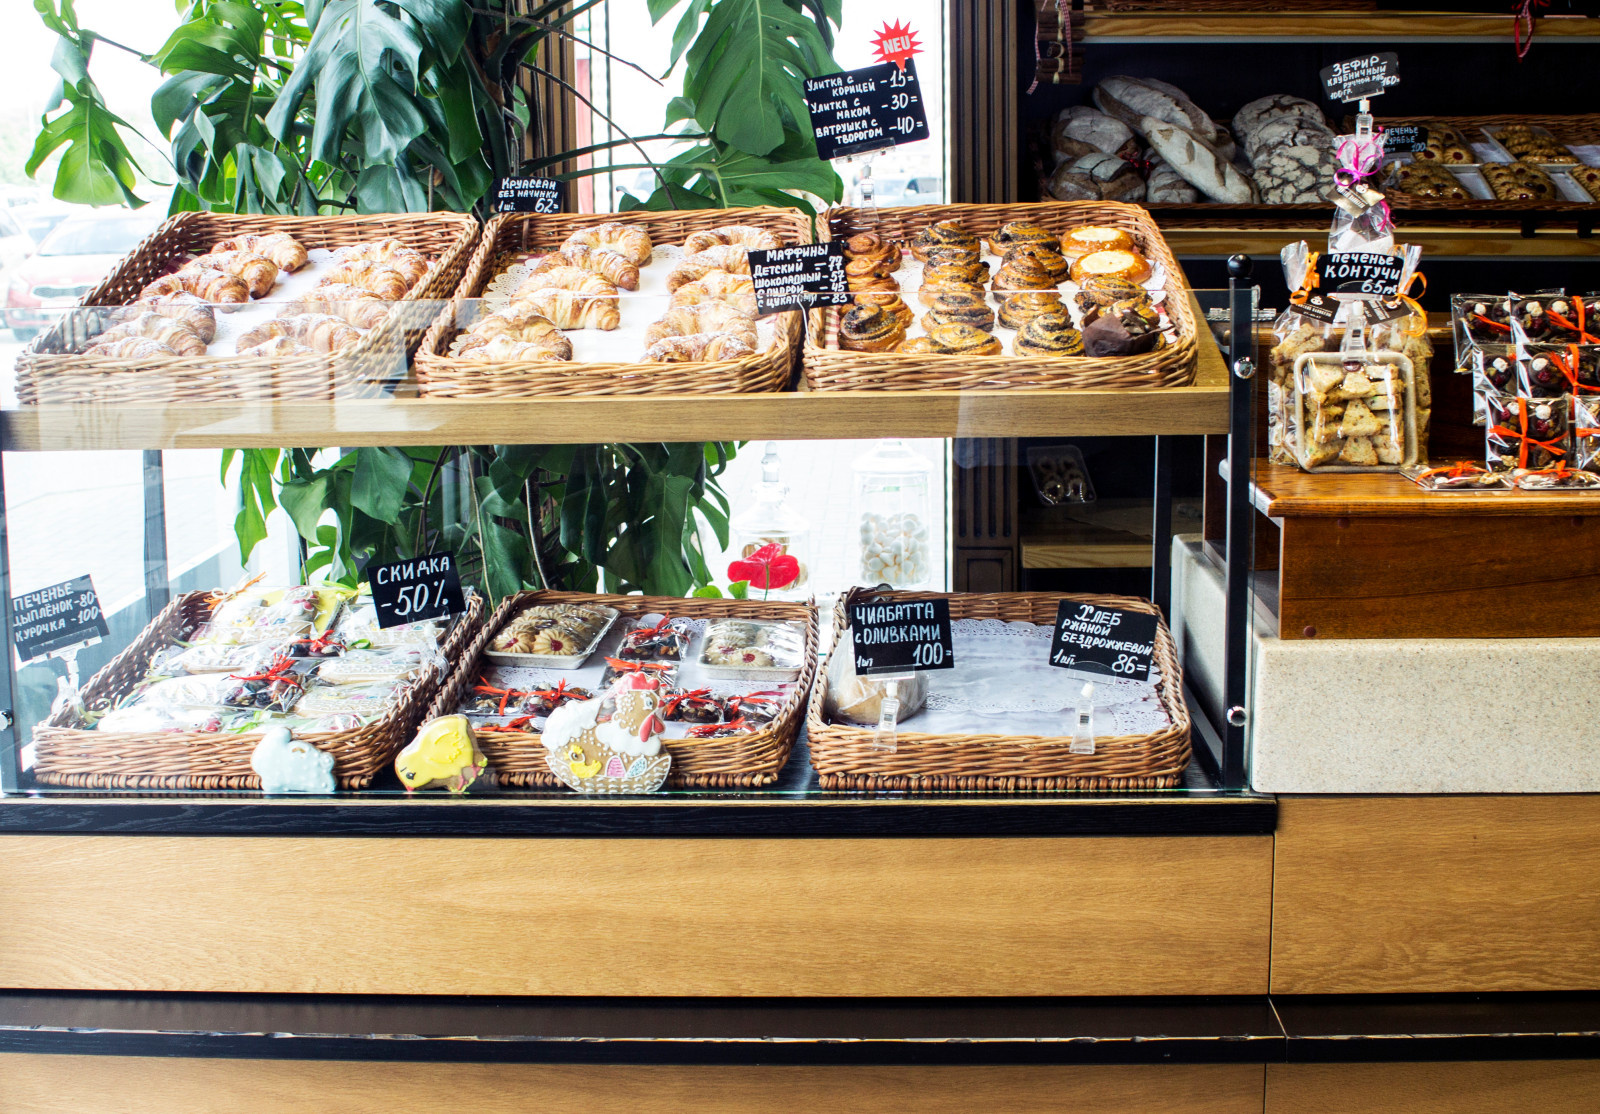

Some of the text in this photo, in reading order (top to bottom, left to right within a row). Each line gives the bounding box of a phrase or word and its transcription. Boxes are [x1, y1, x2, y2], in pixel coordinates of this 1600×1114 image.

[882, 35, 910, 55] NEU
[1327, 61, 1388, 87] КЛУБНИЧНЫЙ
[1332, 55, 1380, 77] ЗЕФИР
[832, 78, 876, 97] КОРИЦЕЙ
[836, 105, 871, 120] МАКОМ
[815, 119, 868, 138] ВАТРУШКА
[835, 127, 883, 144] ТВОРОГОМ
[498, 190, 558, 199] БЕЗ НАЧИНКИ
[766, 245, 828, 262] МАФФИНЫ
[1331, 253, 1394, 265] печенье
[753, 259, 803, 278] ДЕТСКИЙ
[755, 268, 821, 288] ШОКОЛАДНЫЙ
[1324, 265, 1400, 281] КОНТУЧИ
[377, 556, 449, 584] СКИДКА
[13, 582, 74, 611] ПЕЧЕНЬЕ
[381, 579, 448, 616] -50%
[13, 598, 73, 627] ЦЫПЛЁНОК
[856, 602, 934, 625] ЧИАБАТТА
[15, 618, 66, 642] КУРОЧКА
[863, 624, 941, 645] ОЛИВКАМИ
[1061, 618, 1111, 636] РЖАНОЙ
[1061, 631, 1154, 656] БЕЗДРОЖЖЕВОЙ
